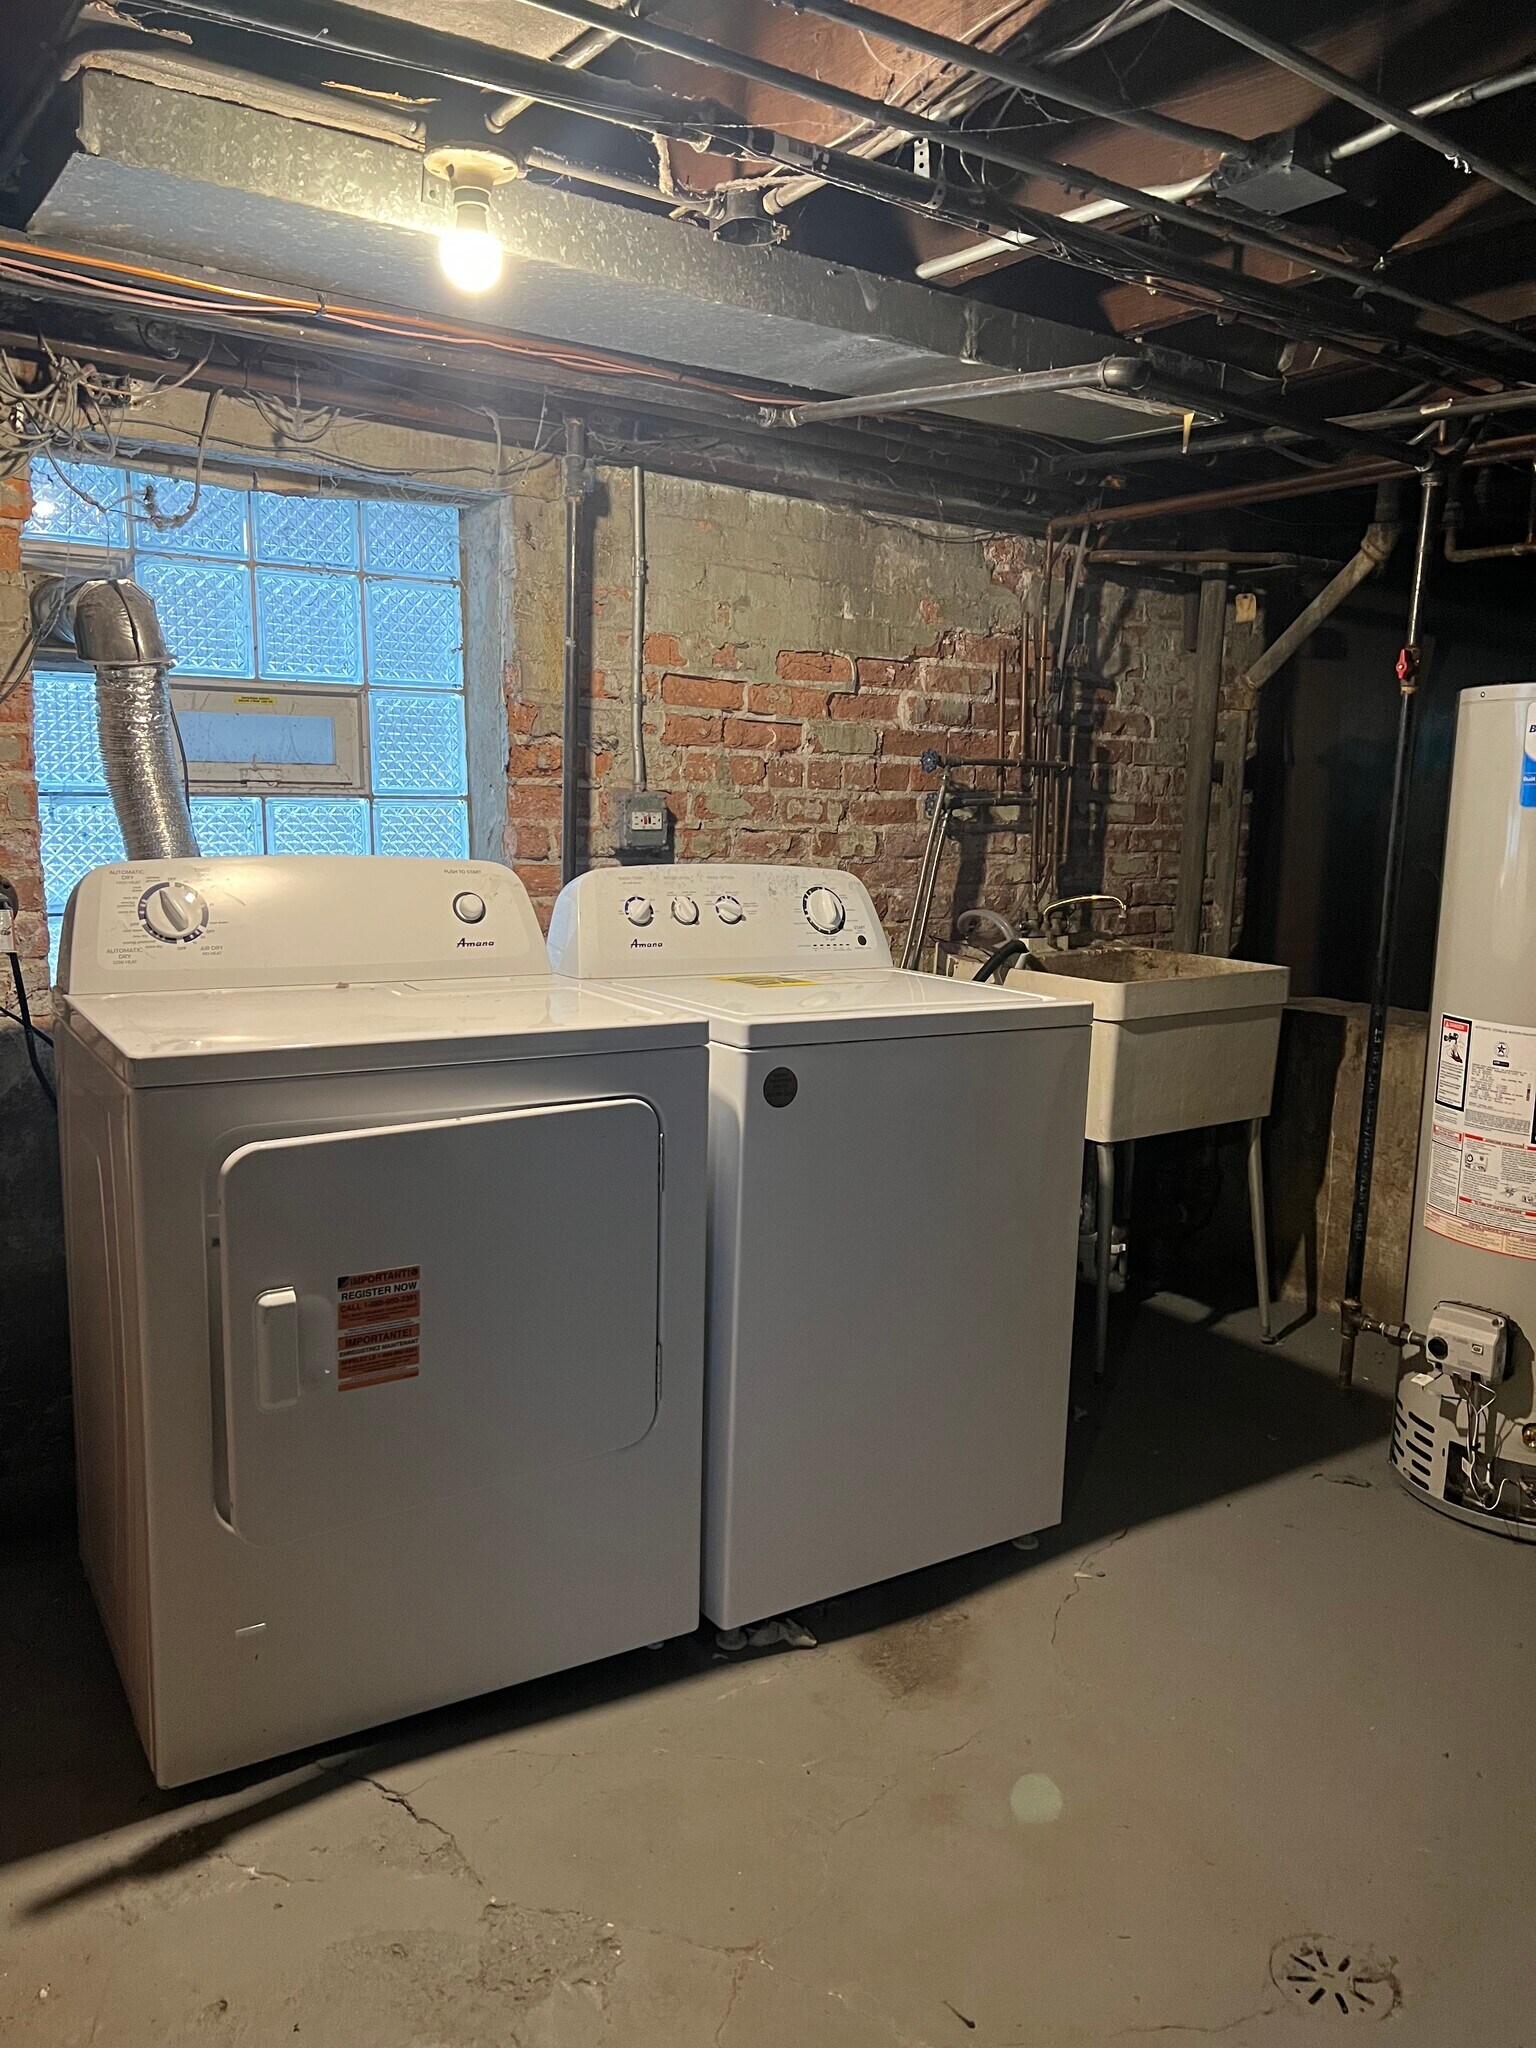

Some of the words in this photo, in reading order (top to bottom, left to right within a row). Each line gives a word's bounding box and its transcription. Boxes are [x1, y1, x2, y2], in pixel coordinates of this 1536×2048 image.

[456, 937, 495, 948] Amana
[630, 938, 663, 948] Amana
[350, 1268, 411, 1286] IMPORTANT!
[341, 1286, 391, 1301] REGISTER
[394, 1281, 417, 1293] NOW
[341, 1302, 361, 1312] CALL
[345, 1328, 412, 1347] IMPORTANTE!
